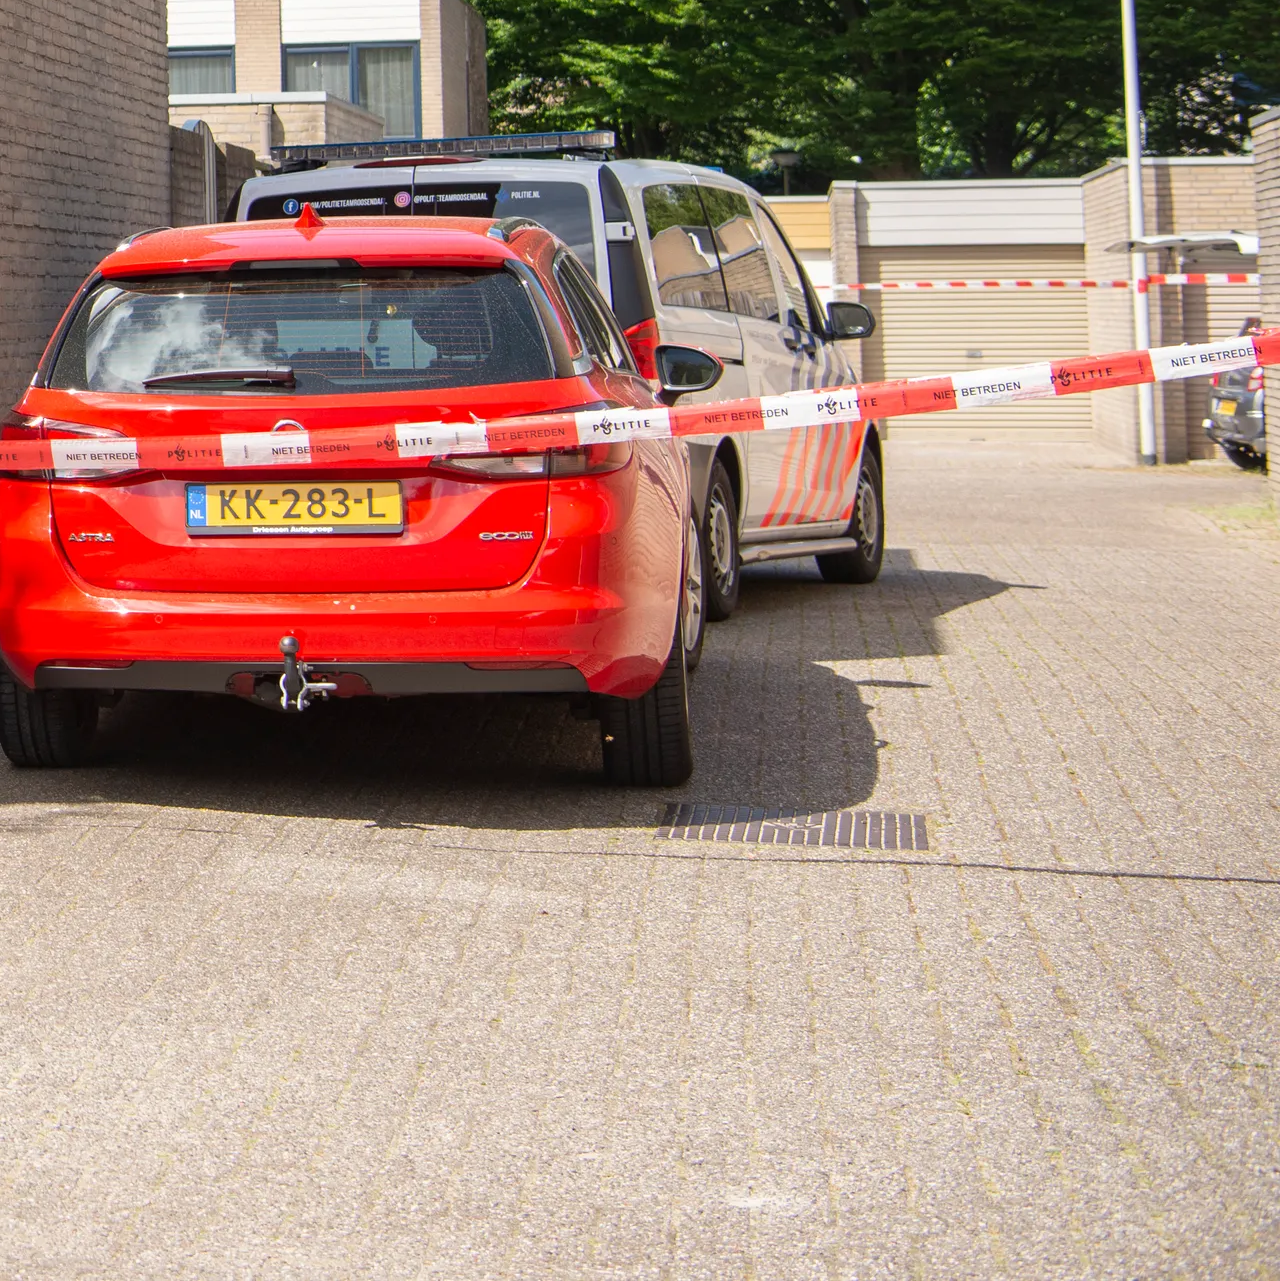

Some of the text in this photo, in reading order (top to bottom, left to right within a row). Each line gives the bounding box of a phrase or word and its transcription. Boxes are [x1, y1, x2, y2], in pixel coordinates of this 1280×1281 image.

[511, 191, 540, 199] POLITIE.NL
[1171, 346, 1262, 367] NIET BETREDEN
[933, 382, 1022, 400] NIET BETREDEN
[704, 408, 788, 424] NIET BETREDEN
[484, 428, 565, 442] NIET BETREDEN
[90, 452, 142, 460] BETREDEN
[272, 444, 350, 456] NIET BETREDEN
[219, 488, 386, 519] KK-283-L
[190, 510, 204, 519] NL
[68, 533, 115, 542] ASTRA
